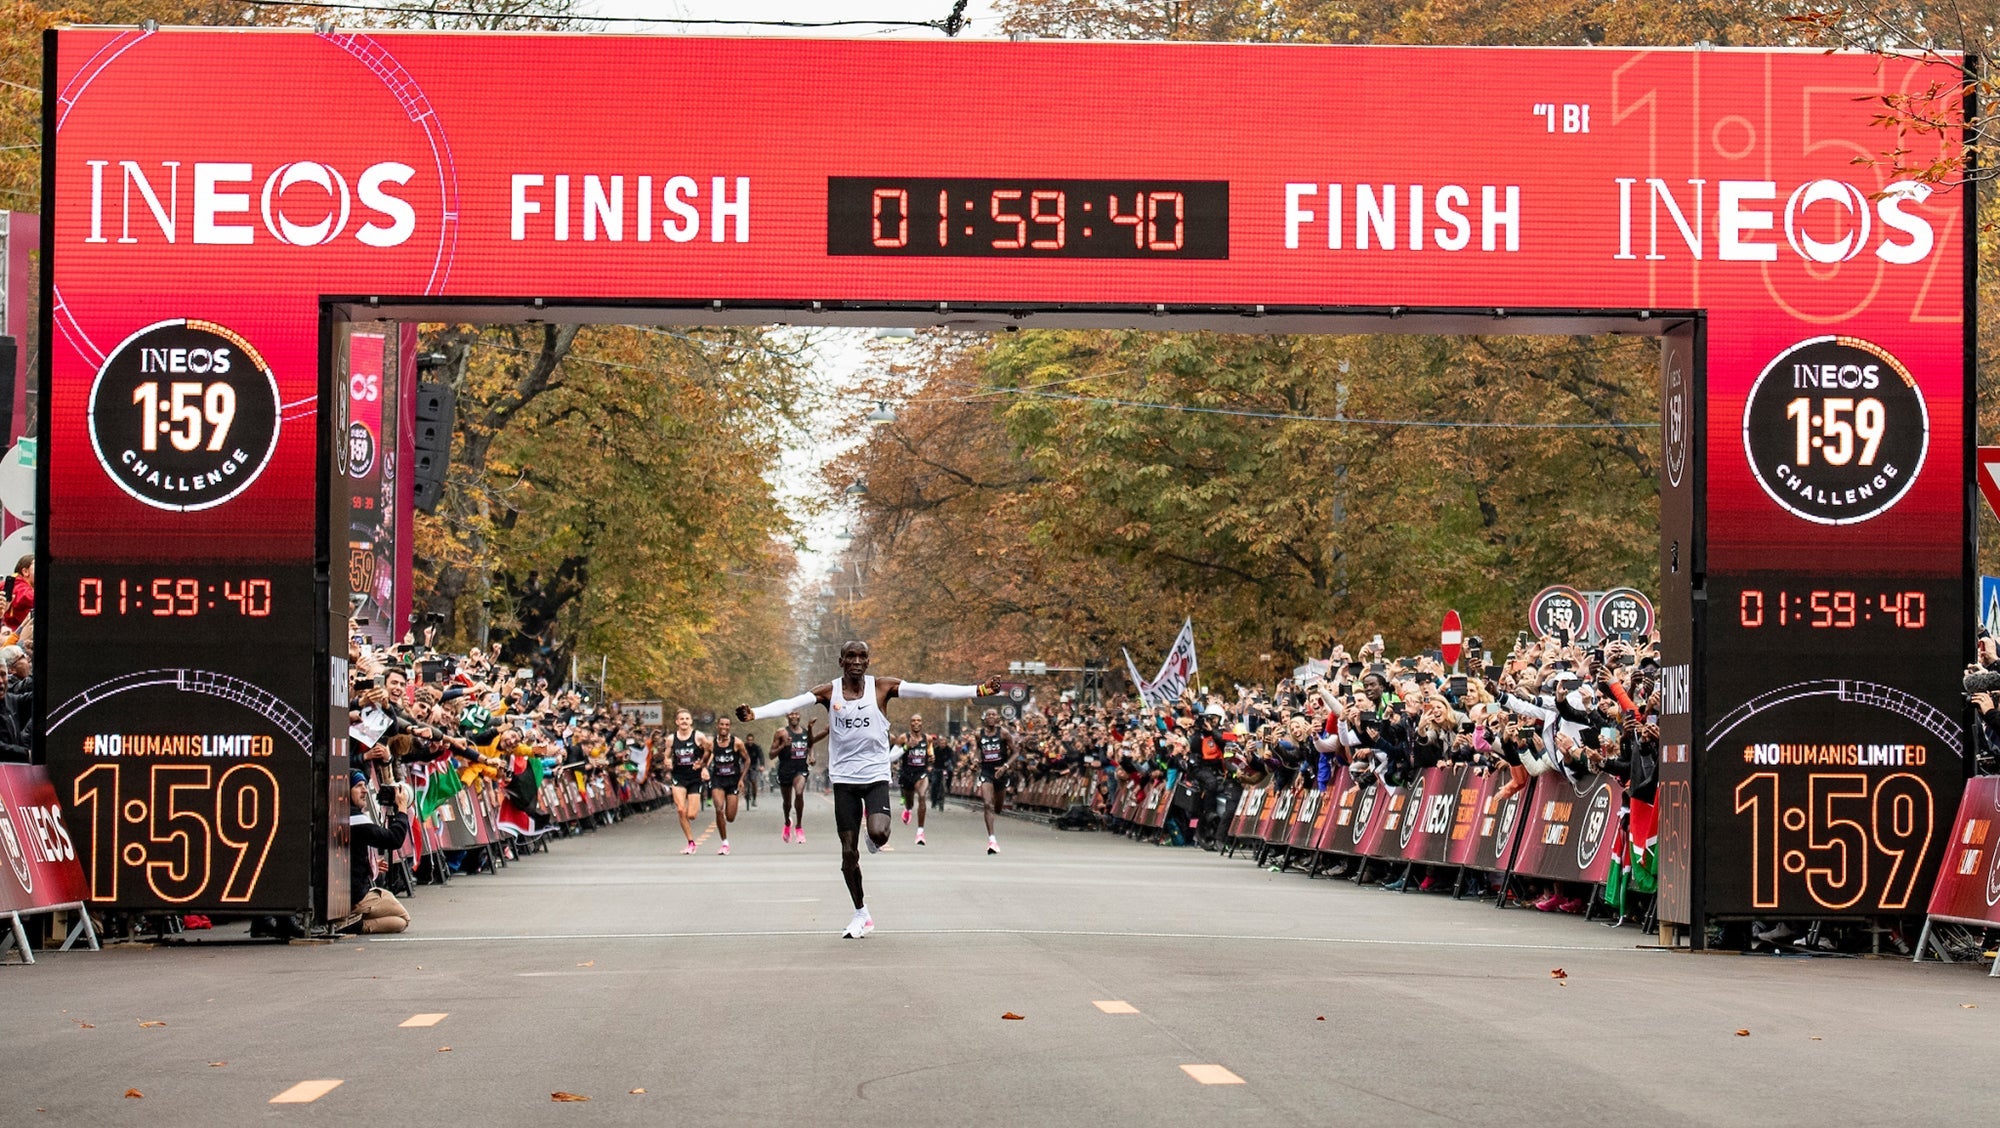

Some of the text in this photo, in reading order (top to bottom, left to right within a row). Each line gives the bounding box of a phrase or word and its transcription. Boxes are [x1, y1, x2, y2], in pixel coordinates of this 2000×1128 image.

[85, 160, 417, 247] INEOS
[511, 174, 751, 243] FINISH
[873, 188, 1185, 251] 01:59:40
[1284, 182, 1521, 252] FINISH
[1613, 178, 1935, 264] INEOS
[140, 348, 231, 373] INEOS
[1793, 364, 1879, 389] INEOS
[132, 381, 237, 451] 1:59
[1787, 397, 1886, 466] 1:59
[121, 448, 249, 491] CHALLENGE
[1775, 462, 1898, 505] CHALLENGE
[79, 578, 272, 616] 01:59:40
[1548, 599, 1572, 607] INEOS
[1613, 601, 1636, 609] INEOS
[1740, 590, 1926, 627] 01:59:40
[1611, 609, 1638, 629] 1:59
[1661, 664, 1690, 715] FINISH
[835, 716, 870, 729] INEOS
[83, 735, 273, 757] #NOHUMANISLIMITED
[1743, 744, 1926, 765] #NOHUMANISLIMITED
[19, 804, 74, 862] INEOS
[74, 764, 279, 902] 1:59
[1419, 794, 1454, 834] INEOS
[1735, 772, 1934, 909] 1:59
